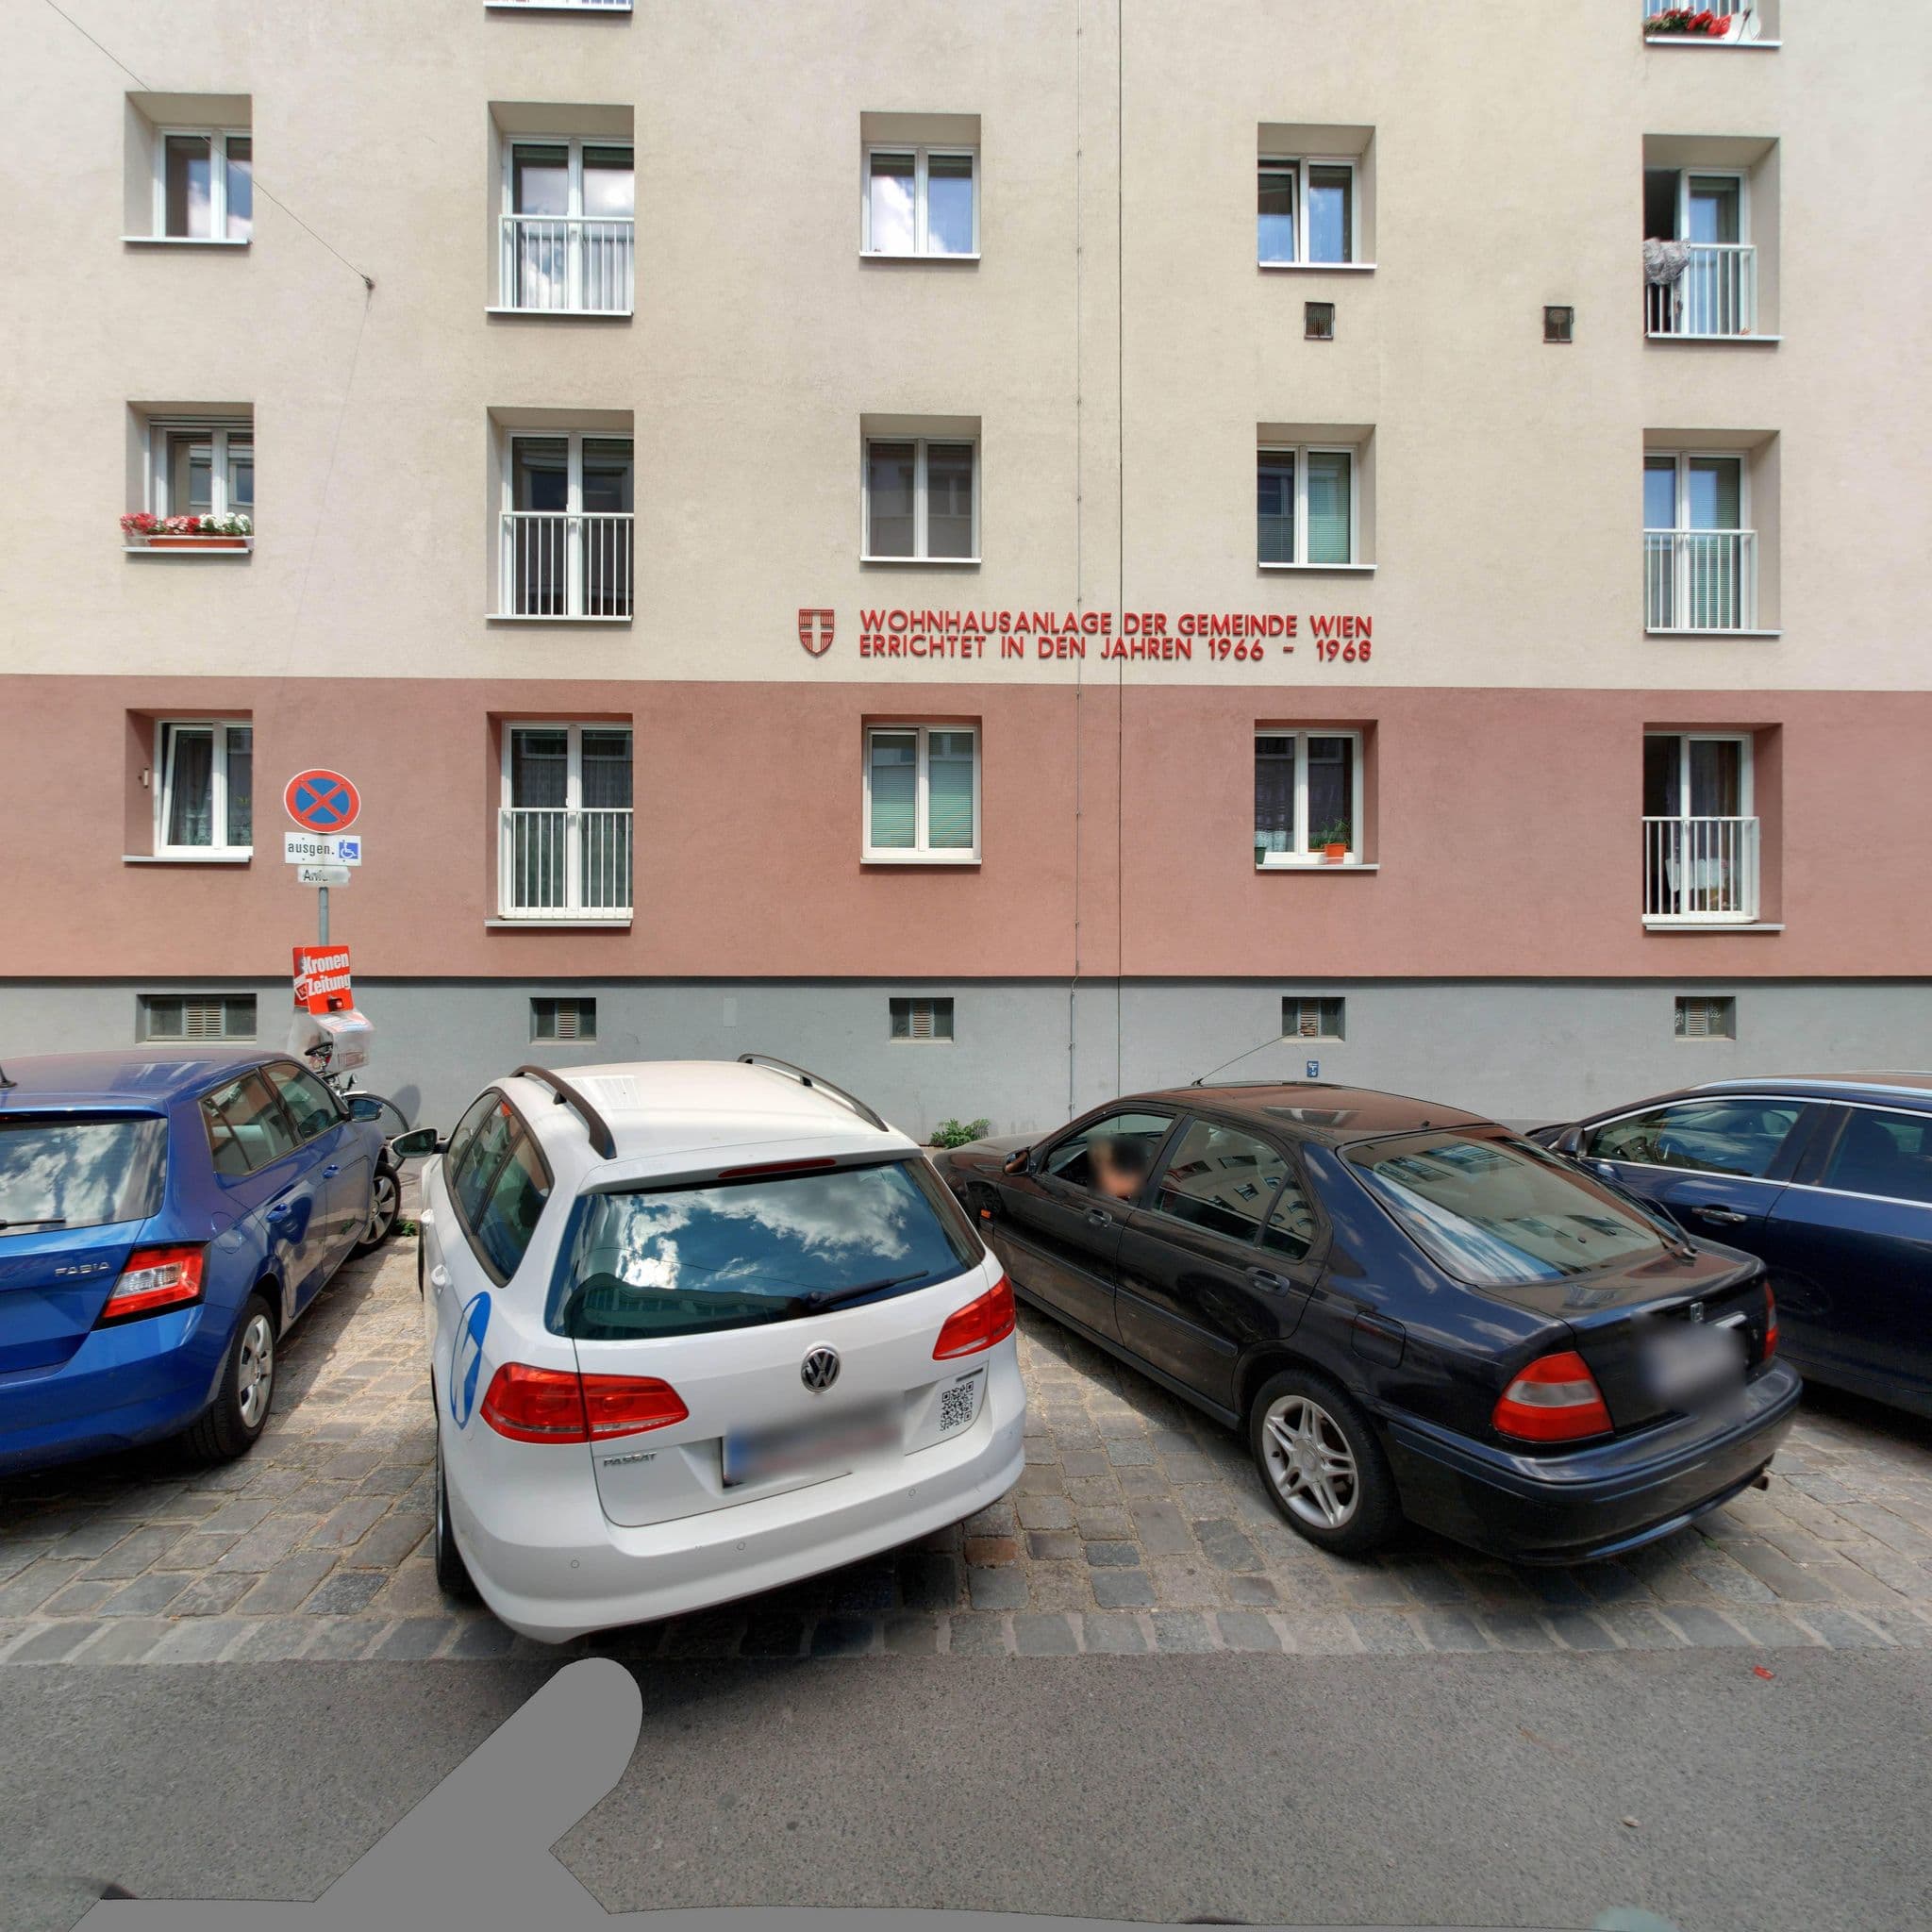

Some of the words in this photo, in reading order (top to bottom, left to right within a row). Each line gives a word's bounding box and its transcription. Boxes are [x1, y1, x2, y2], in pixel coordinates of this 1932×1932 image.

[859, 609, 1112, 634] WOHNHAUSANLAGE
[1124, 611, 1168, 635] DER
[1177, 613, 1298, 637] GEMEINDE
[1309, 614, 1374, 637] WIEN
[859, 634, 987, 658] ERRICHTET
[1001, 636, 1025, 658] IN
[1038, 636, 1087, 658] DEN
[1101, 637, 1192, 659] JAHREN
[1208, 638, 1265, 660] 1966
[1316, 640, 1373, 661] 1968
[288, 842, 335, 857] ausgen.
[302, 953, 349, 974] Kronen
[307, 974, 351, 996] Zeitung
[55, 1262, 109, 1275] FABIA
[604, 1452, 658, 1466] PASSAT
